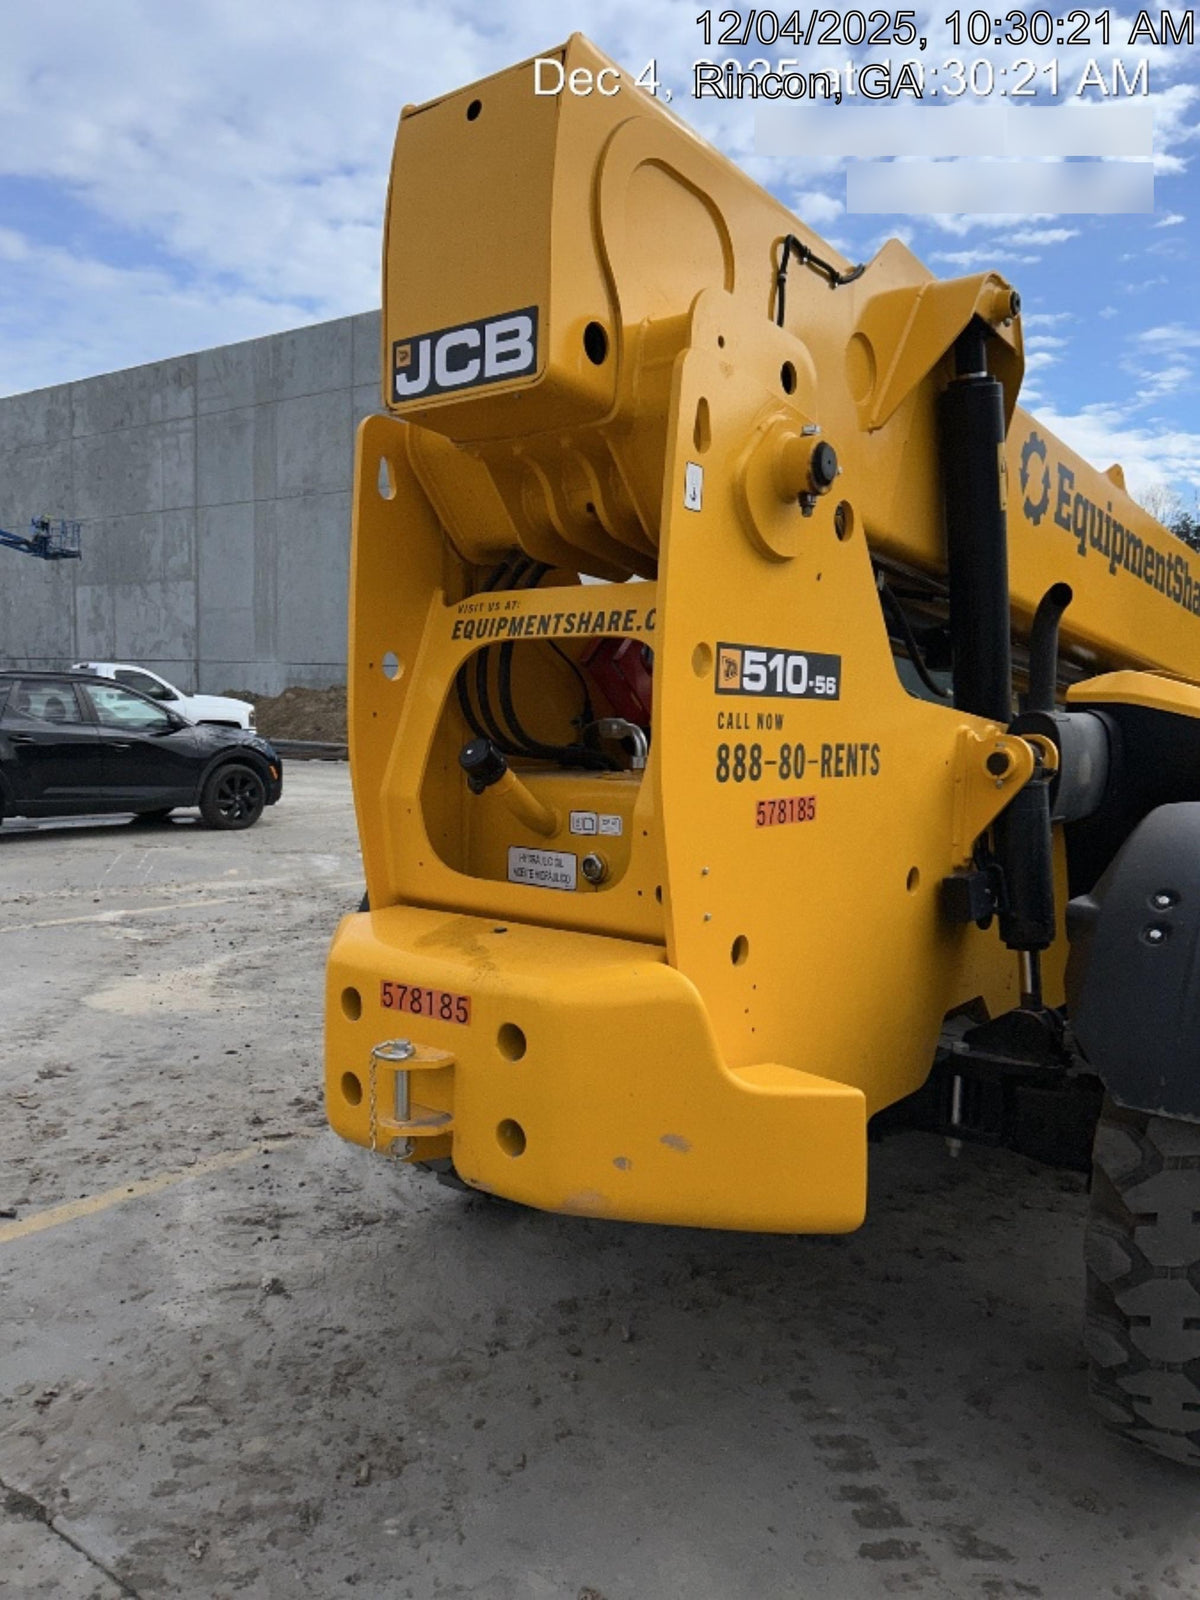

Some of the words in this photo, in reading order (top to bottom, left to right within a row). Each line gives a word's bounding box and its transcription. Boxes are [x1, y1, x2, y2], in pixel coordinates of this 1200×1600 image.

[396, 315, 534, 396] JCB
[458, 602, 484, 614] VISIT
[487, 601, 500, 611] US
[505, 600, 520, 610] AT:
[718, 712, 750, 730] CALL
[757, 713, 784, 730] NOW
[716, 743, 880, 783] 888-80-RENTS
[757, 797, 815, 826] 578185
[382, 982, 469, 1023] 578185
